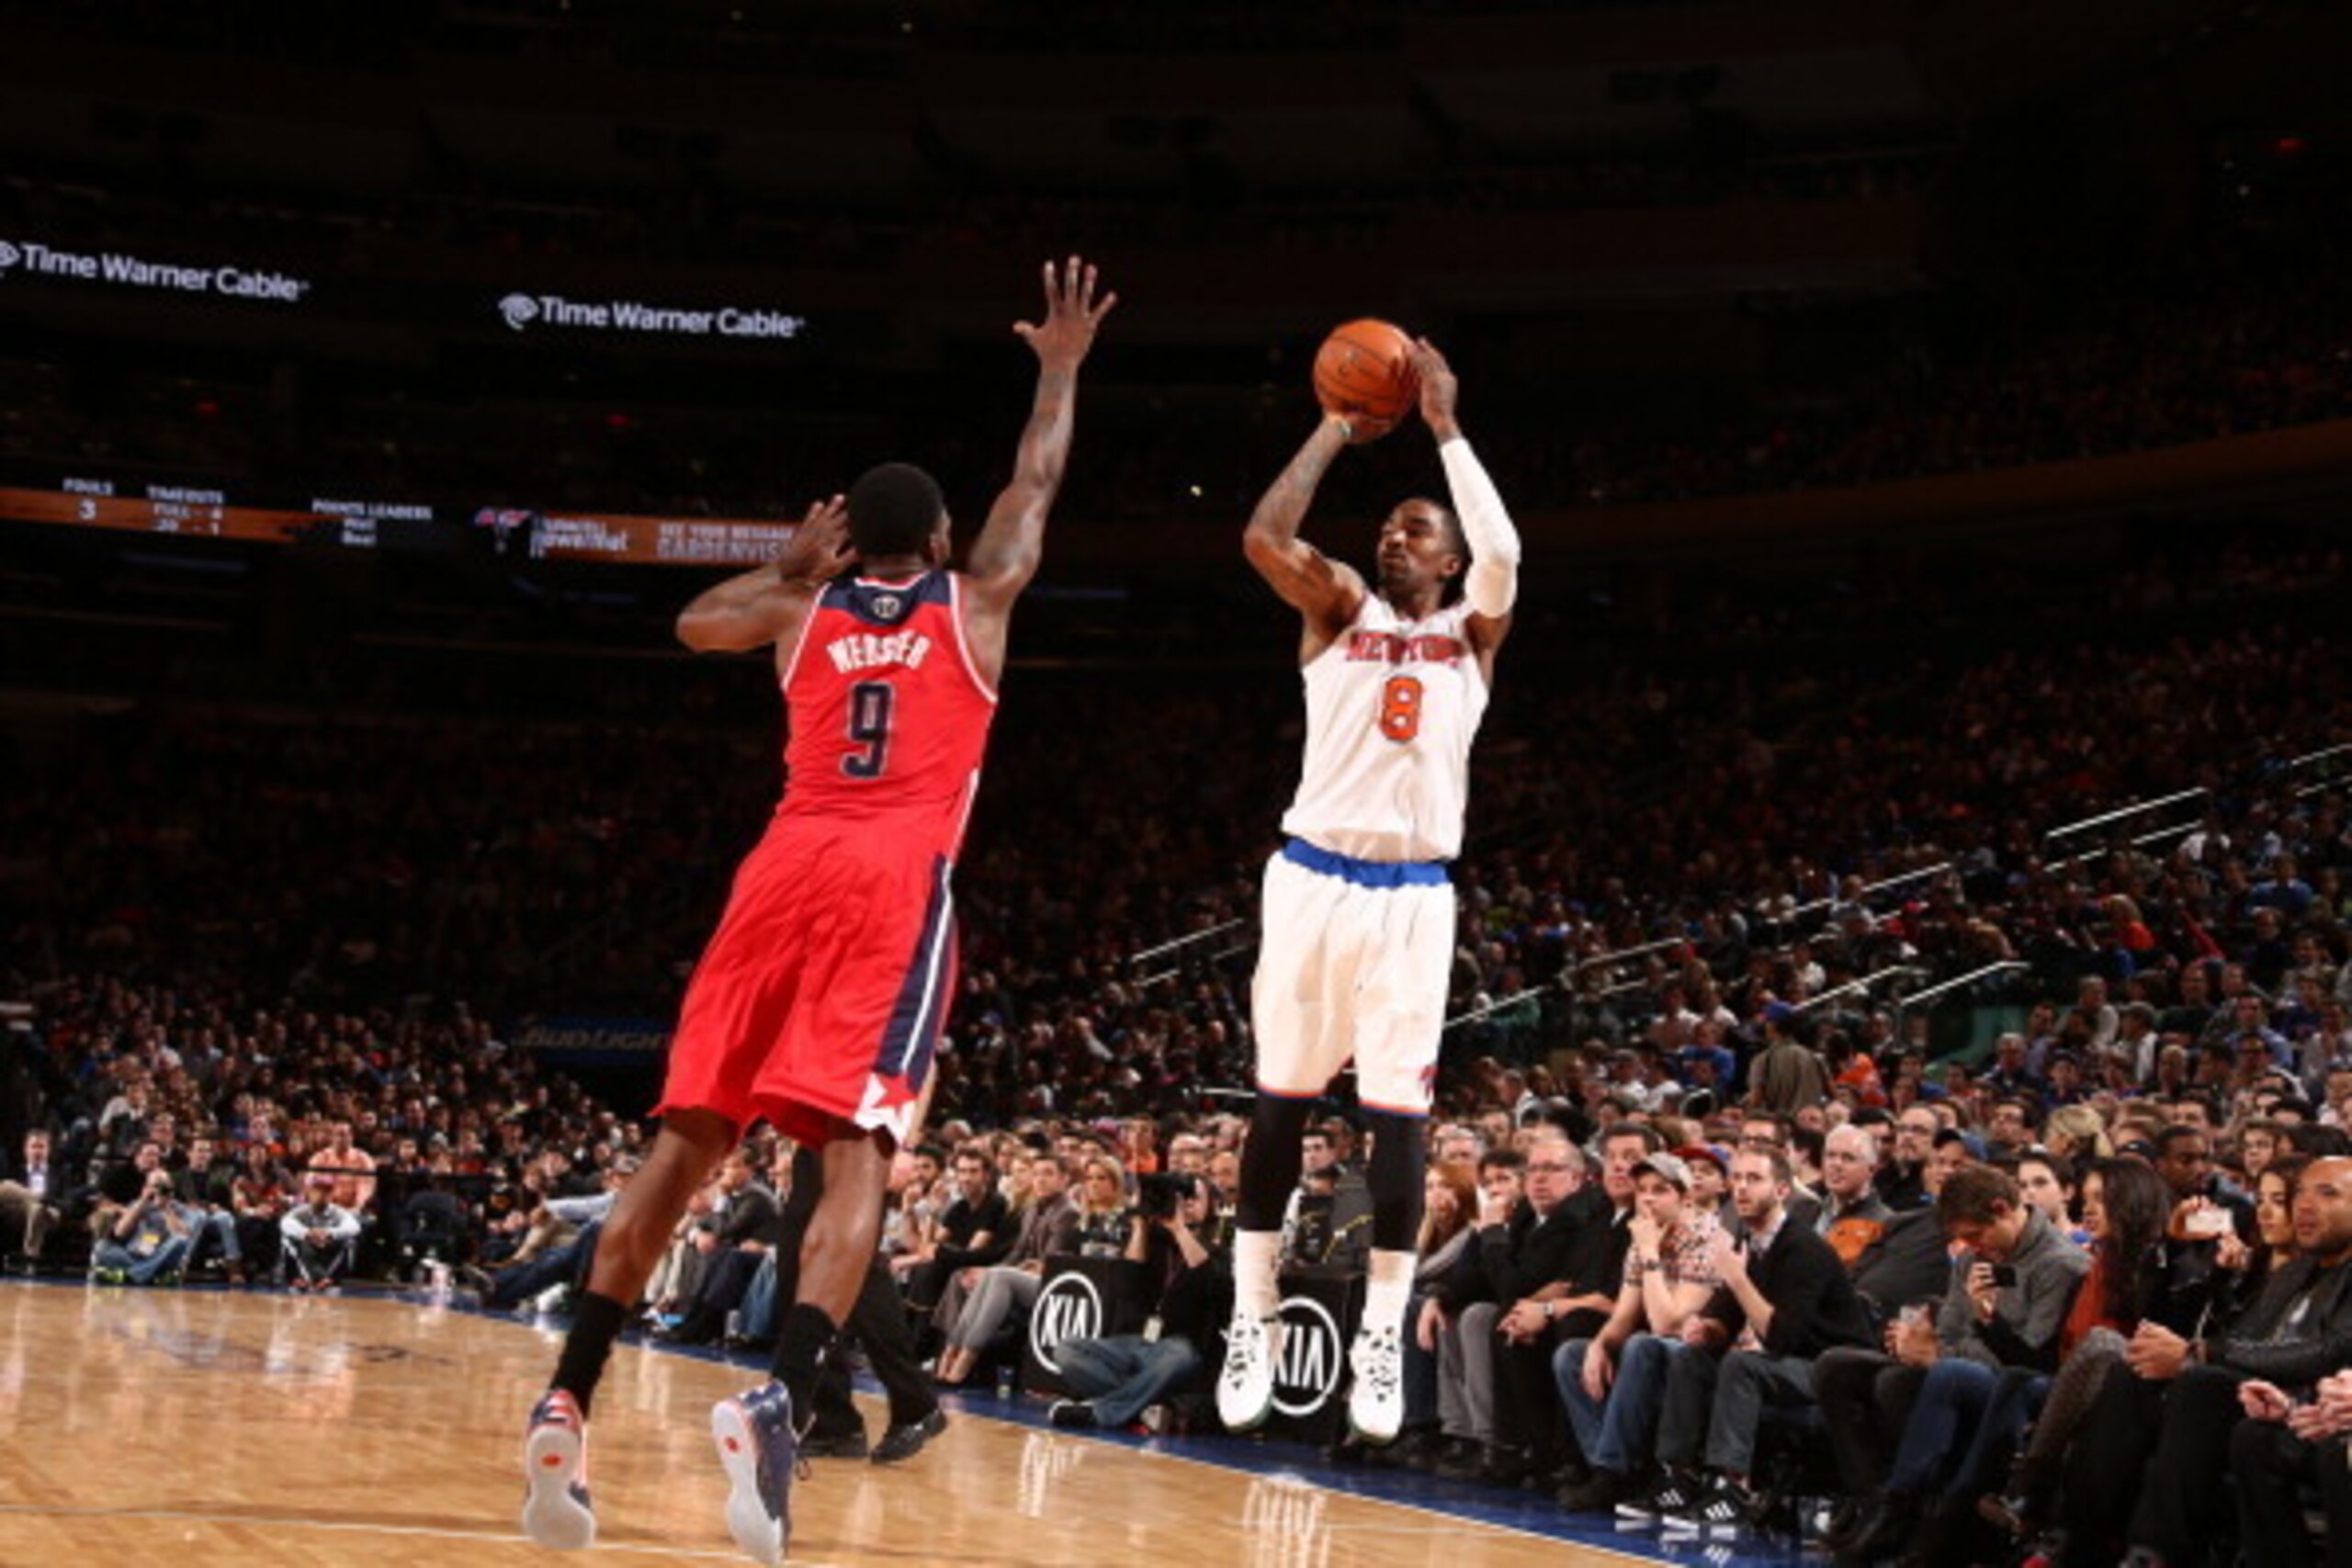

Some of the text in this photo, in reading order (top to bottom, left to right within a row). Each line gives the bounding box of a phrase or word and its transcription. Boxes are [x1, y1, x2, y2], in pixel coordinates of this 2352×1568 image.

[20, 243, 301, 301] Time Warner Cable
[537, 295, 796, 338] Time Warner Cable
[79, 497, 96, 521] 3
[840, 680, 896, 778] 9
[1379, 674, 1425, 745] 8
[1040, 1293, 1089, 1348] KIA
